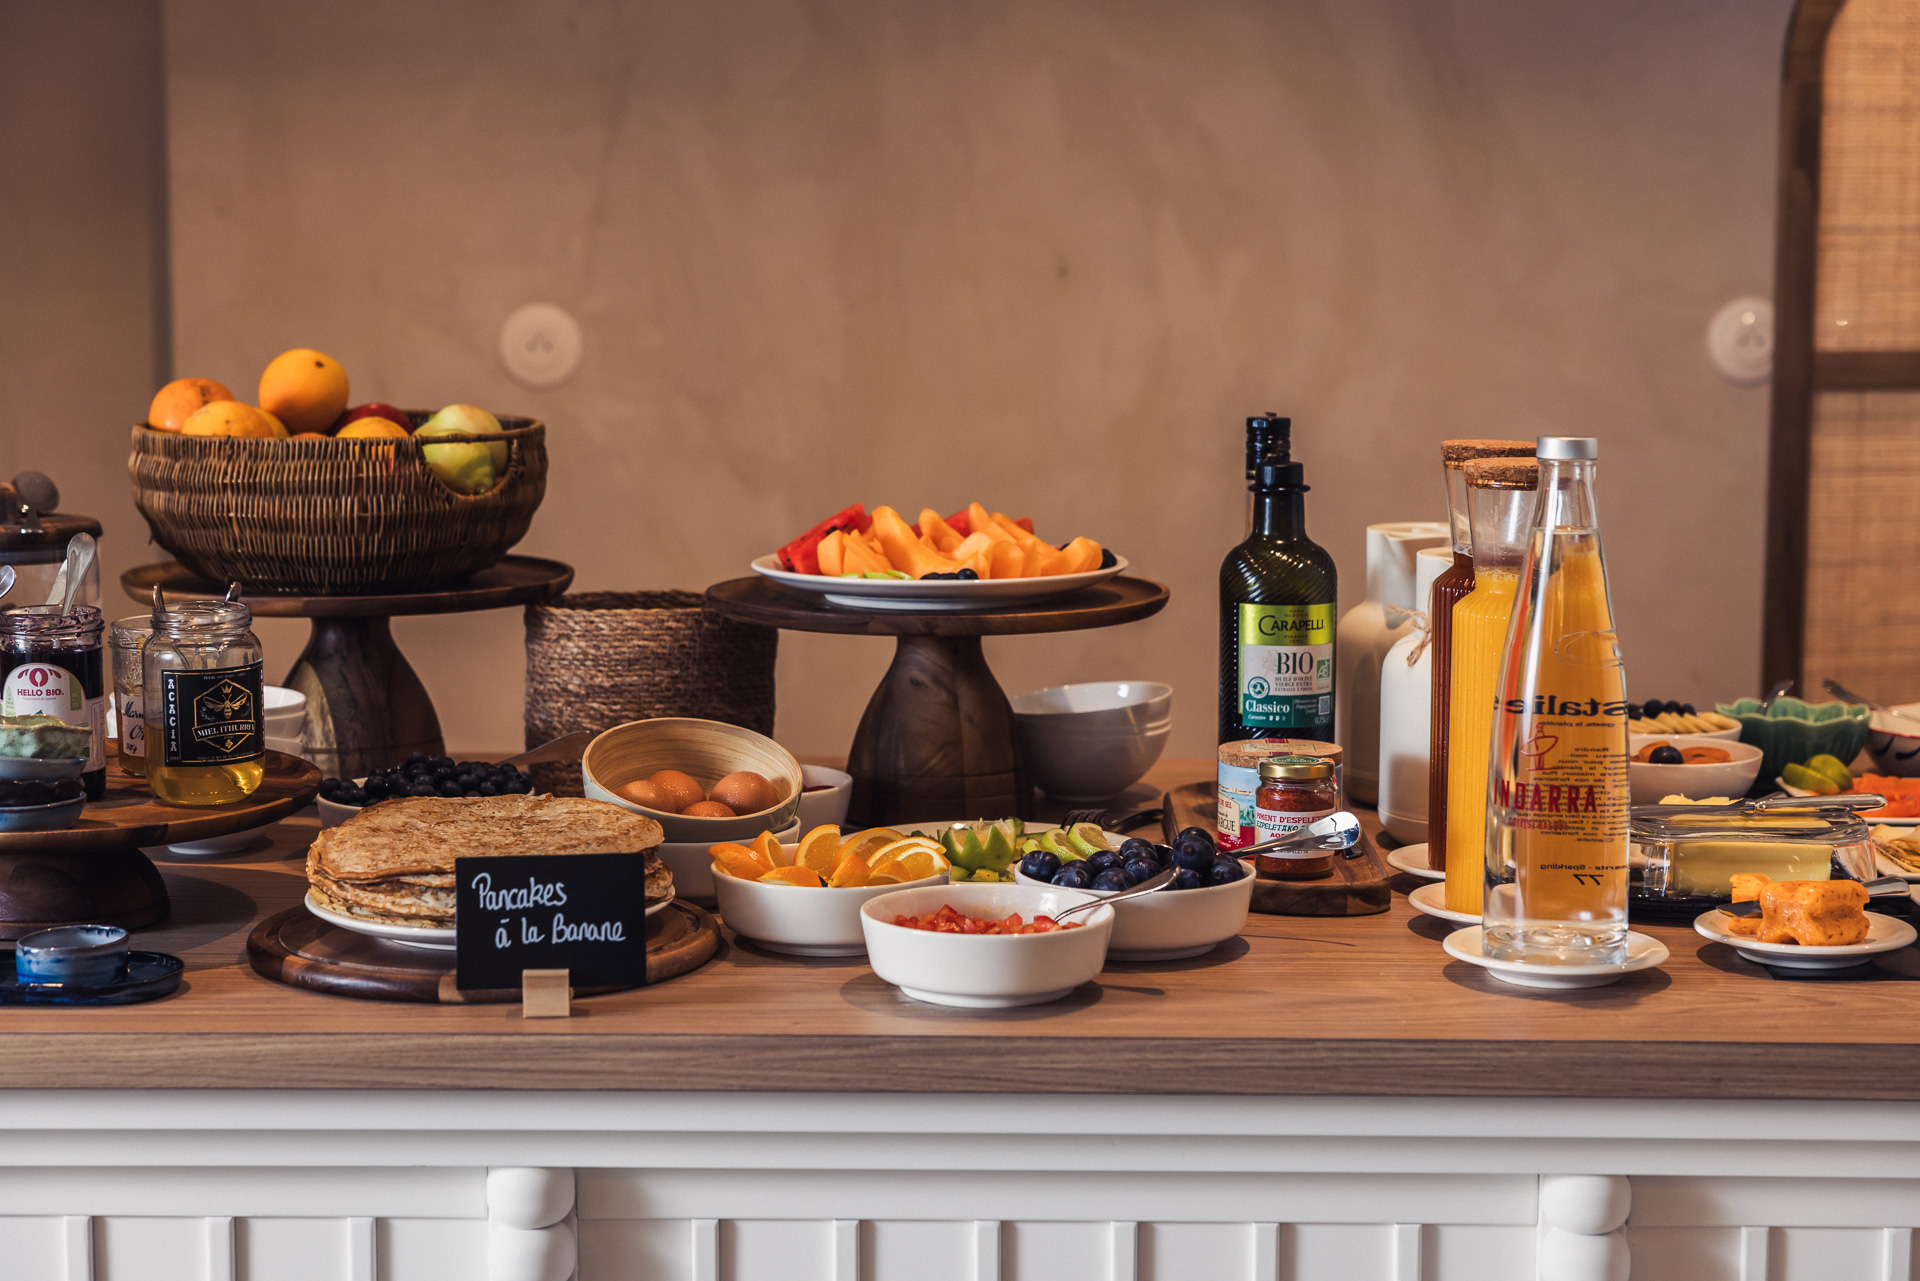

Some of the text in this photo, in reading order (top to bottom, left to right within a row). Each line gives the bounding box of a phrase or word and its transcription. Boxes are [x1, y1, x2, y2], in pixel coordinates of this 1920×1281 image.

[1258, 615, 1324, 636] CARAPELLI
[1276, 652, 1314, 675] BIO
[17, 688, 65, 697] HELLO BIO.
[1245, 699, 1290, 714] Classico
[197, 729, 219, 738] MIEL
[1494, 778, 1597, 813] INDARRA
[1256, 811, 1278, 823] PIMENT
[1256, 820, 1299, 831] EZPELETAKO
[472, 872, 567, 911] Pancakes
[521, 917, 545, 944] la
[552, 913, 626, 944] Banane
